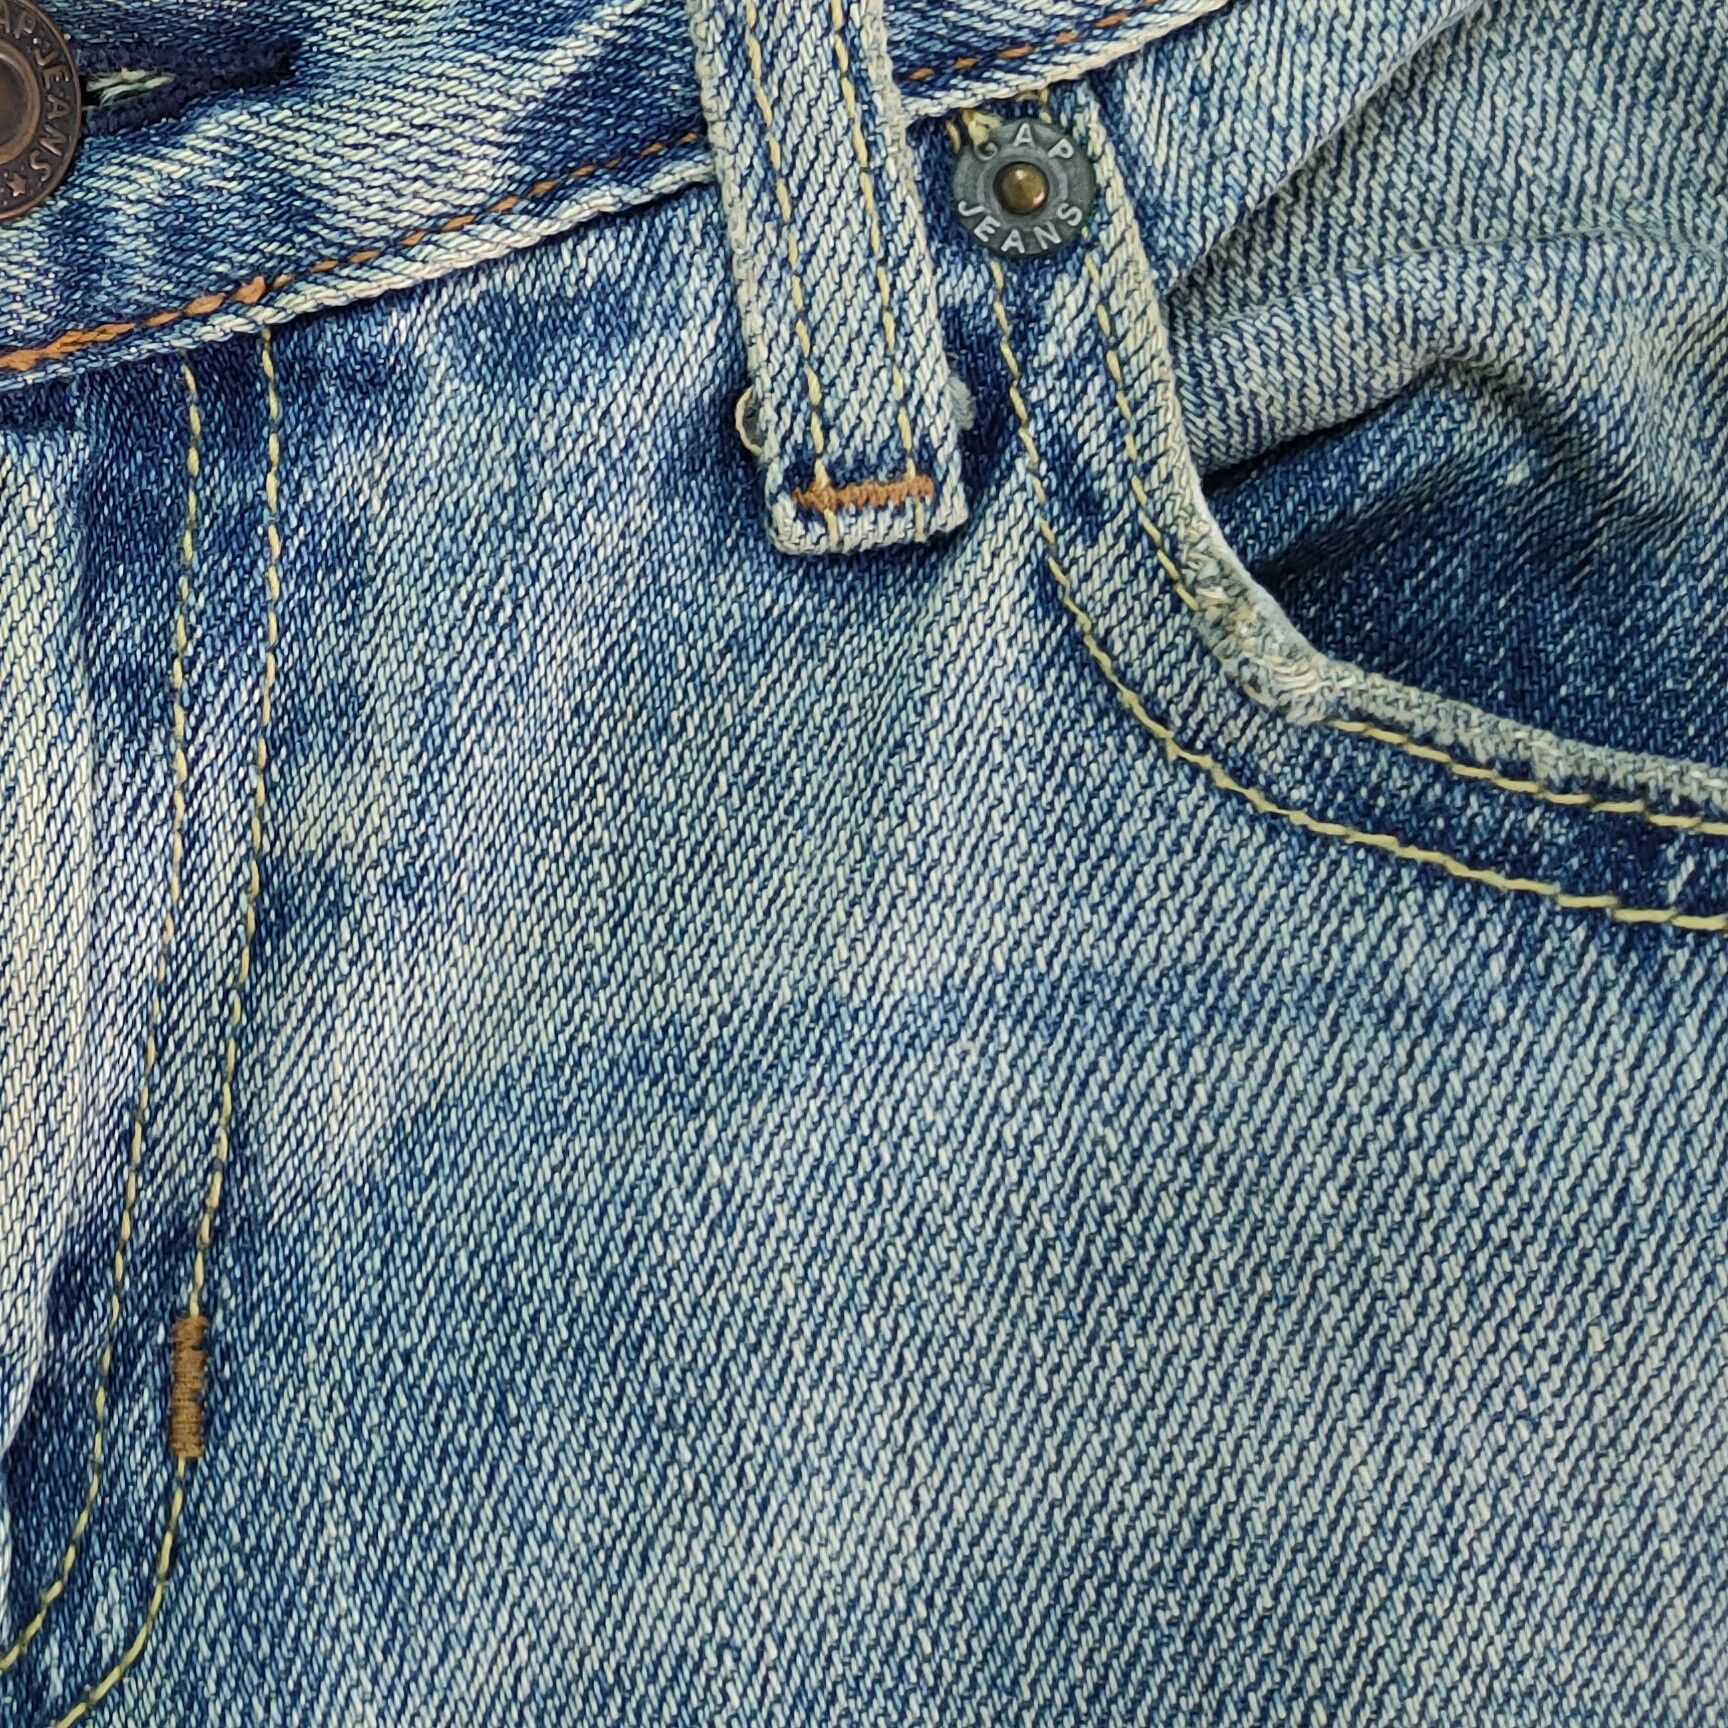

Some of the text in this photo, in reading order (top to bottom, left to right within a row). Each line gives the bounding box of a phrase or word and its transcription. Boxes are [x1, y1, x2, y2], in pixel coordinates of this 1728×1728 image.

[29, 46, 73, 182] JEANS
[975, 123, 1074, 161] GAP
[959, 201, 1083, 254] JEANS
